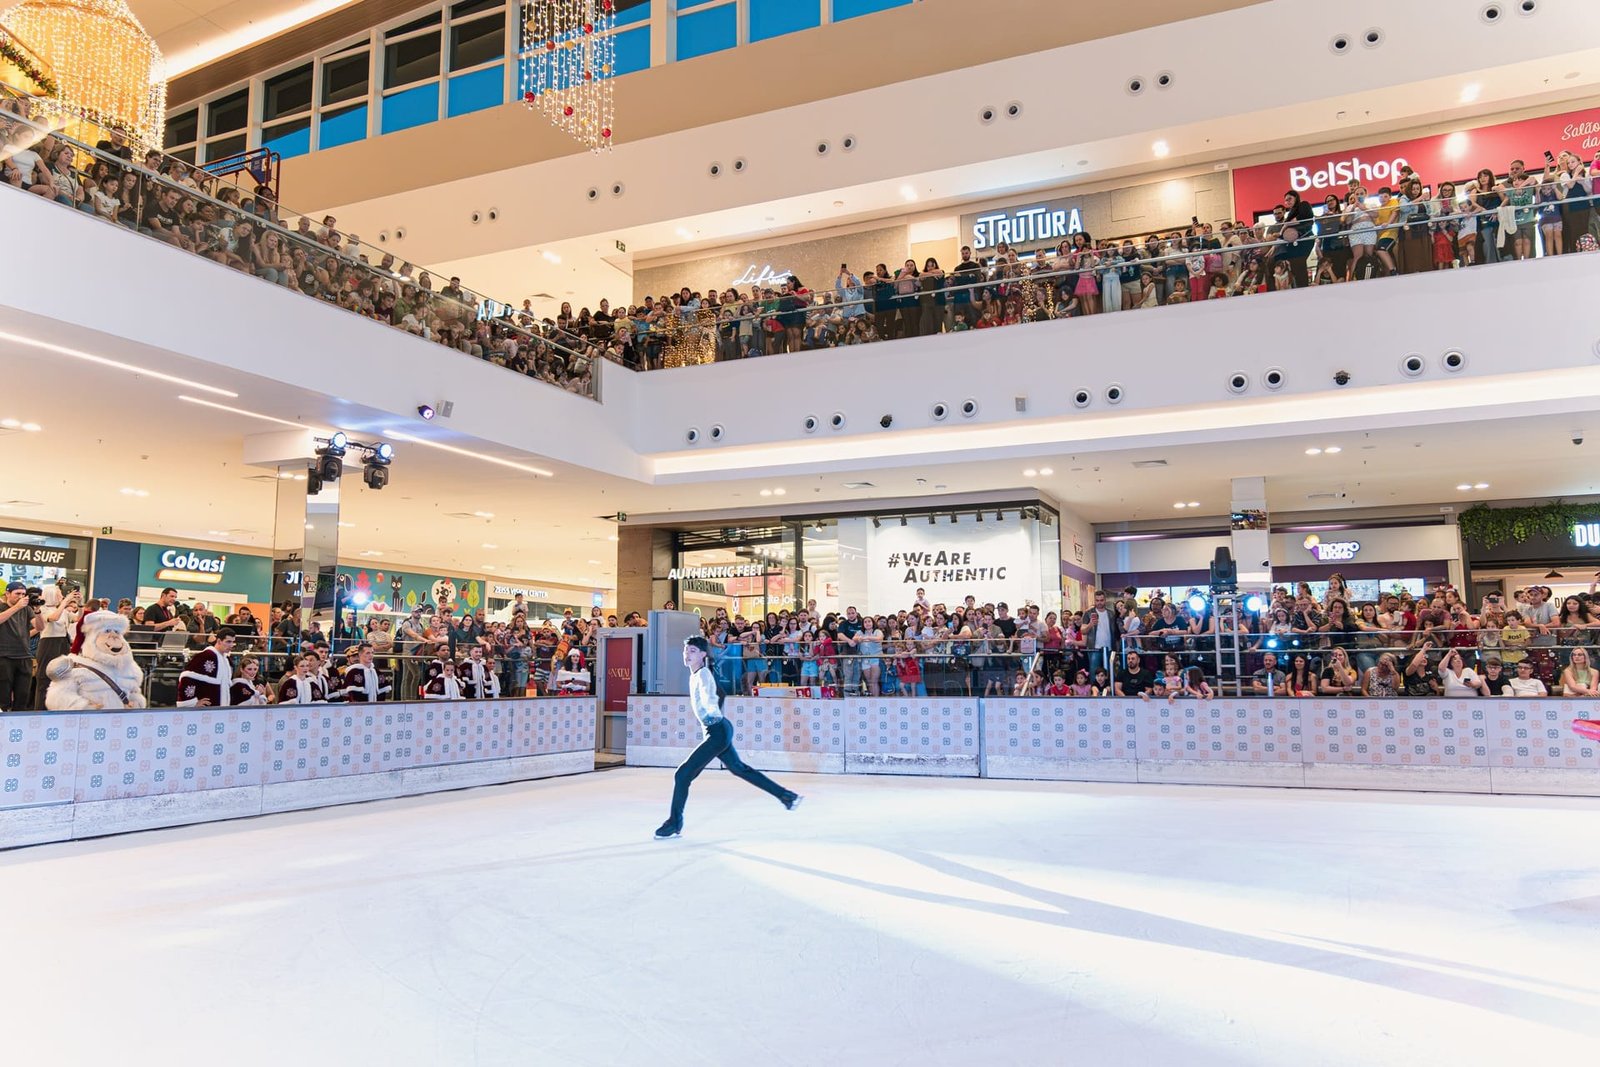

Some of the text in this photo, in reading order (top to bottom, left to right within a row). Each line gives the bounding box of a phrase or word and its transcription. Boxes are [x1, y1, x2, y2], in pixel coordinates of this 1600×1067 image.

[1289, 157, 1408, 192] BelShop
[973, 207, 1083, 249] STRUTURA
[0, 546, 65, 563] NETA SURF
[161, 549, 227, 573] Cobasi
[667, 564, 764, 580] AUTHENTIC FEET
